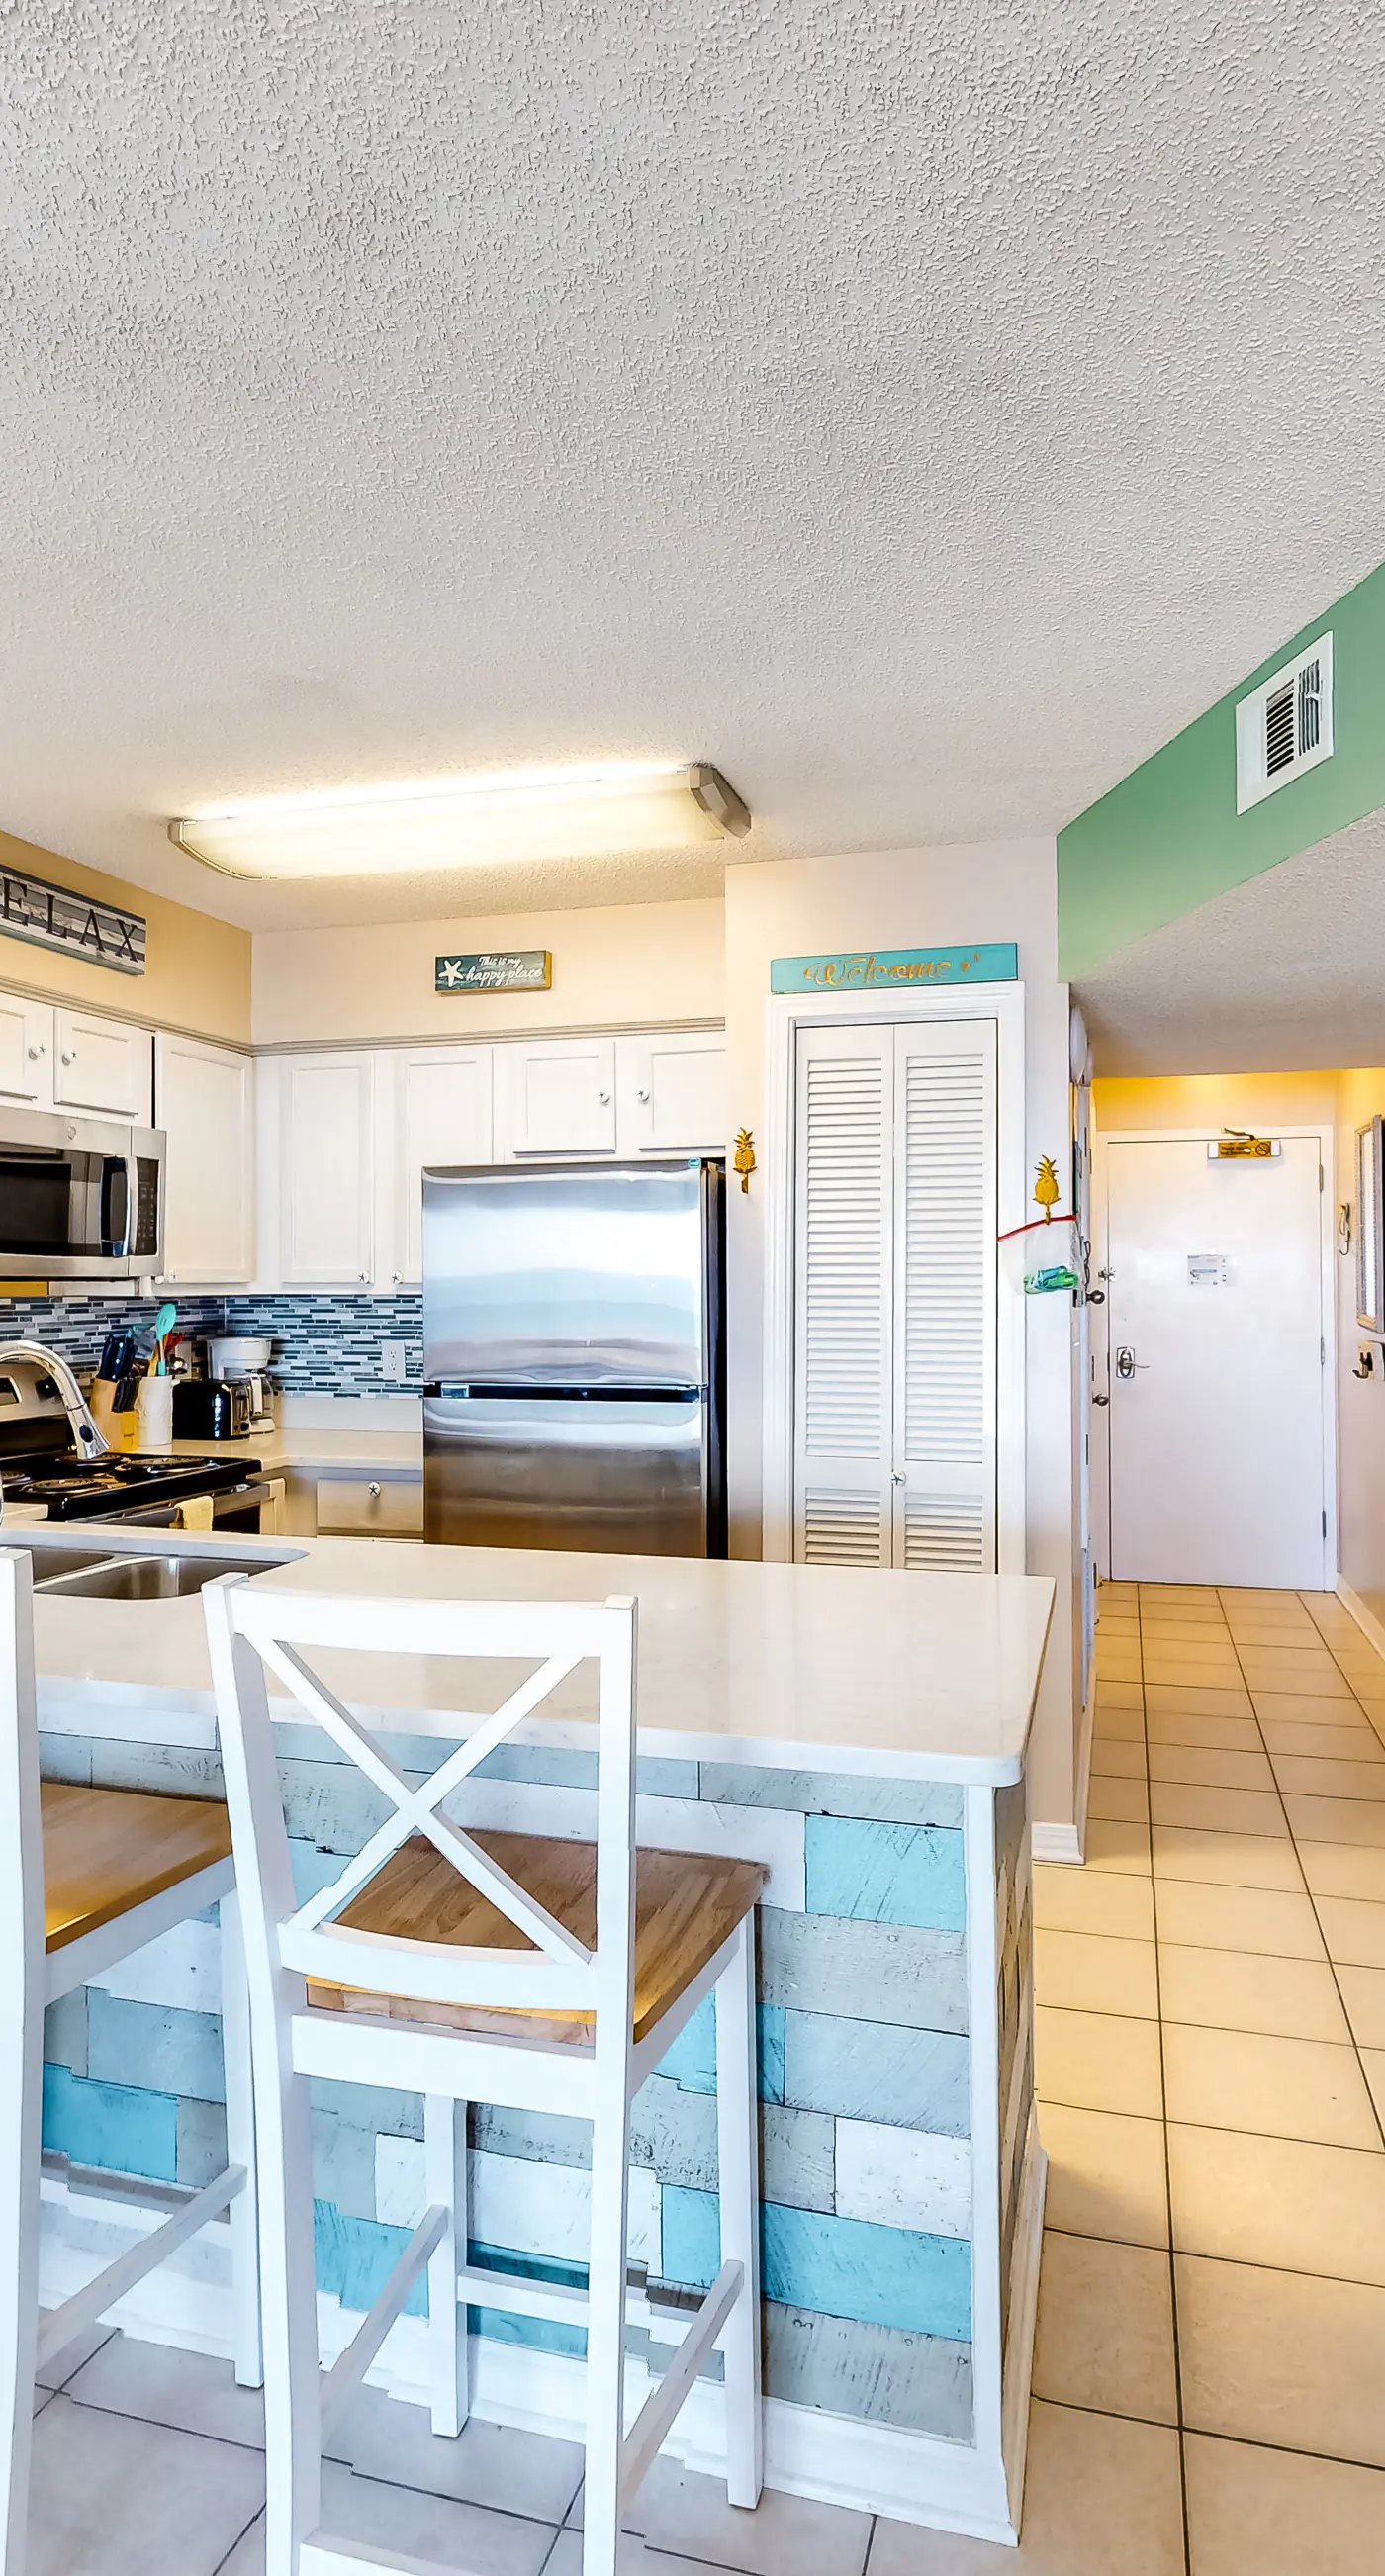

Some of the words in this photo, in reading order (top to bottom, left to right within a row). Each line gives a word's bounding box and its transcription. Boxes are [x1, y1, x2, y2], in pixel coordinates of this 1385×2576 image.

[479, 956, 497, 966] This
[498, 957, 507, 966] is
[508, 956, 522, 969] my
[803, 955, 951, 986] Welcome
[466, 966, 508, 987] happy
[506, 964, 543, 986] place
